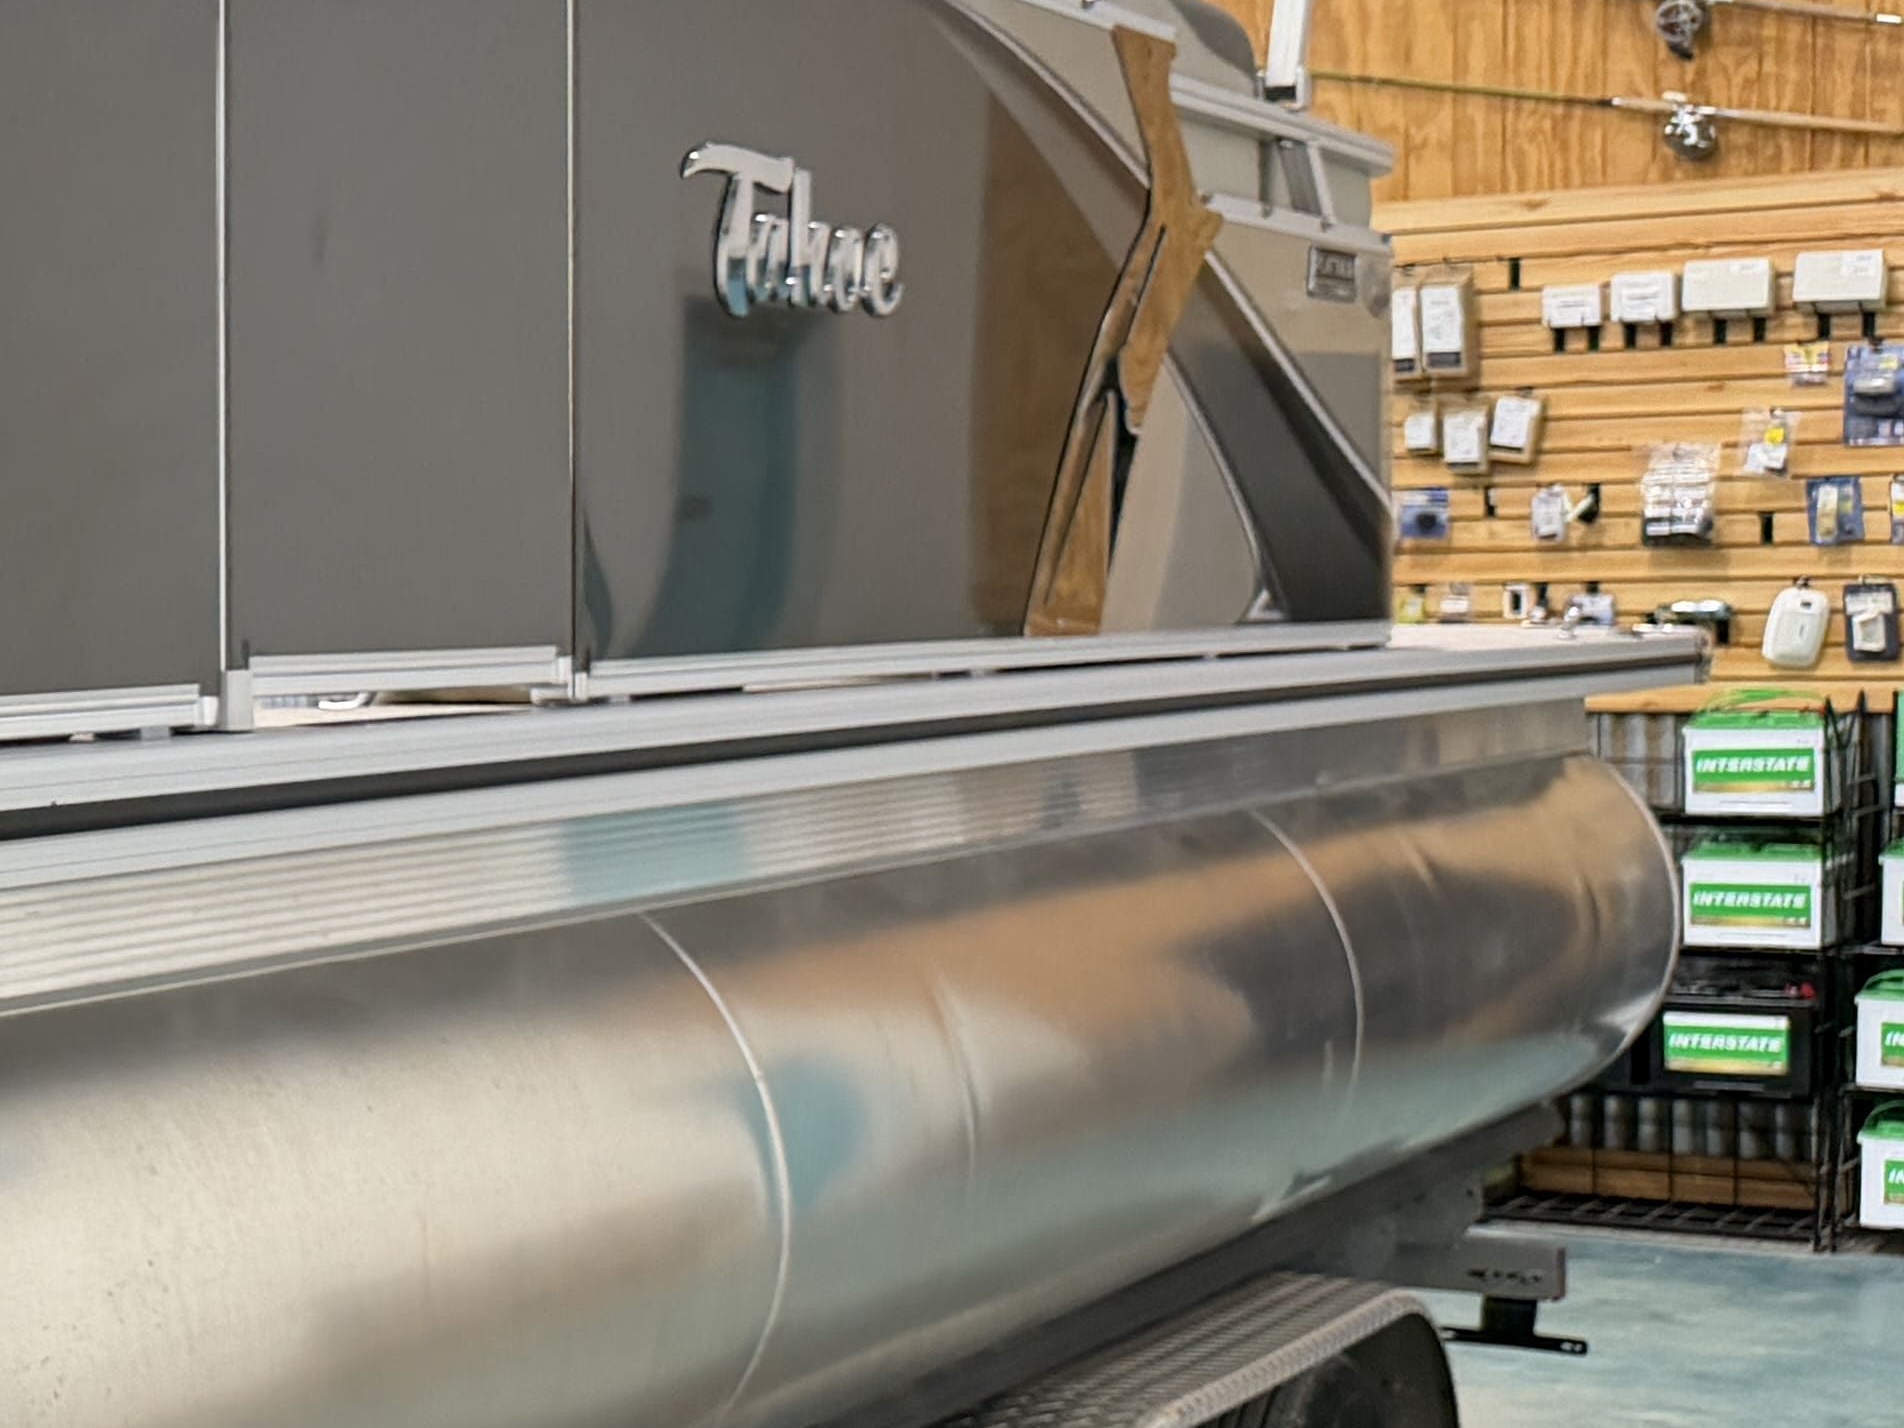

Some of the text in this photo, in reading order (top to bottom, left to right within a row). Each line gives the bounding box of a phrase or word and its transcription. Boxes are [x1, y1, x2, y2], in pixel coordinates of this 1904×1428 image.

[680, 140, 904, 318] Tahoe
[1695, 756, 1811, 773] INTERSTATE
[1692, 891, 1808, 909] INTERSTATE
[1668, 1033, 1783, 1053] INTERSTATE
